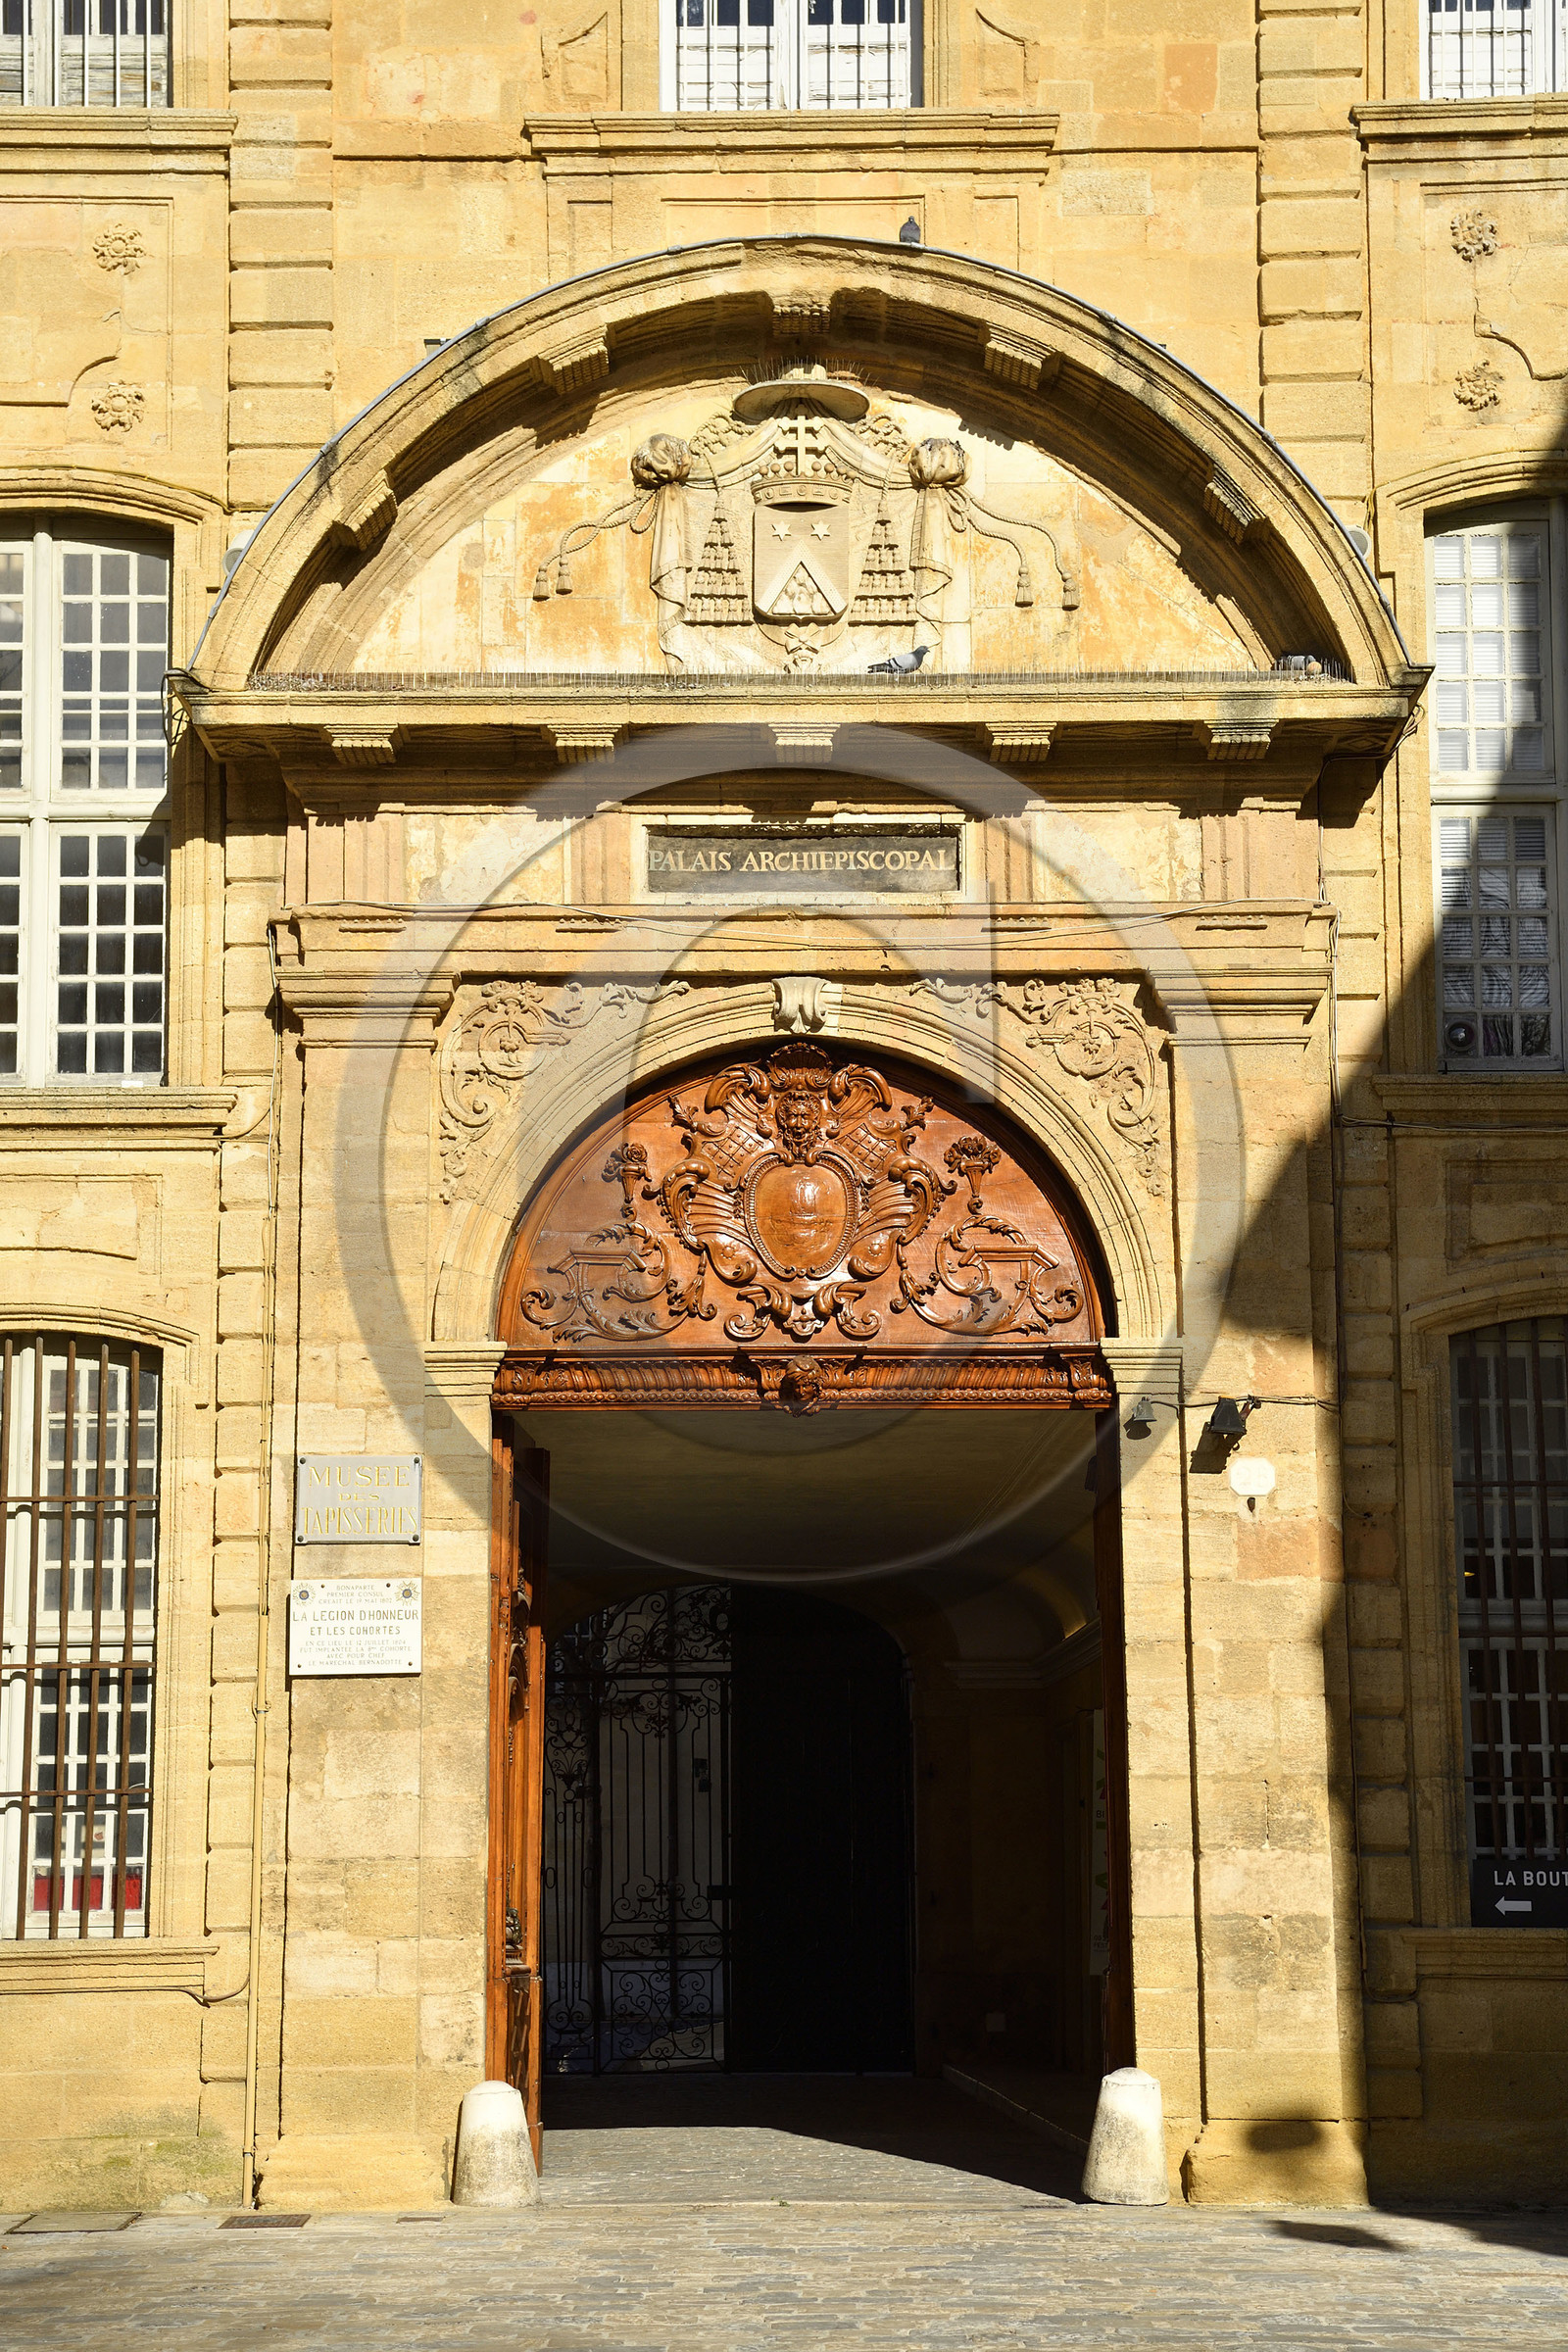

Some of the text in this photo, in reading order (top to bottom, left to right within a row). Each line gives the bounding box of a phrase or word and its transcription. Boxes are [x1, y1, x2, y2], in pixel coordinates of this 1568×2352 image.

[648, 849, 956, 872] PALAIS ARCHIEPISCOPAL
[308, 1465, 410, 1488] MUSEE
[339, 1493, 380, 1501] DES
[301, 1506, 417, 1535] TAPISSERIES
[292, 1611, 308, 1622] LA
[313, 1610, 355, 1621] LEGION
[310, 1625, 401, 1636] ET LES COHORTES
[1494, 1870, 1568, 1886] LA BOUT
